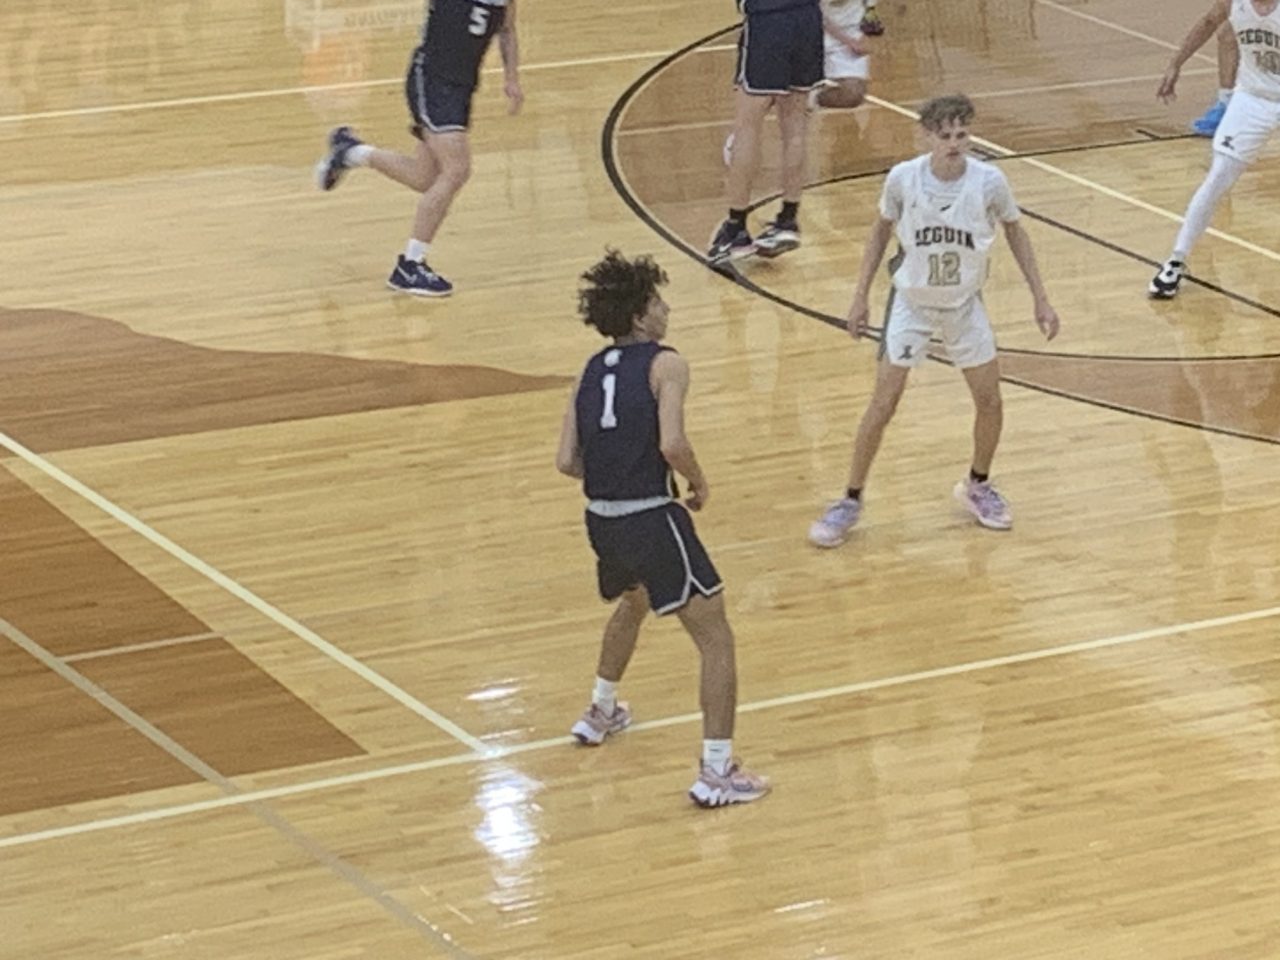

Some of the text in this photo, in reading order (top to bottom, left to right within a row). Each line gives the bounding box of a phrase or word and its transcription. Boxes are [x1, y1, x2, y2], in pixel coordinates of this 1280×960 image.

[468, 6, 491, 36] 5
[927, 251, 961, 287] 12
[600, 373, 618, 430] 1
